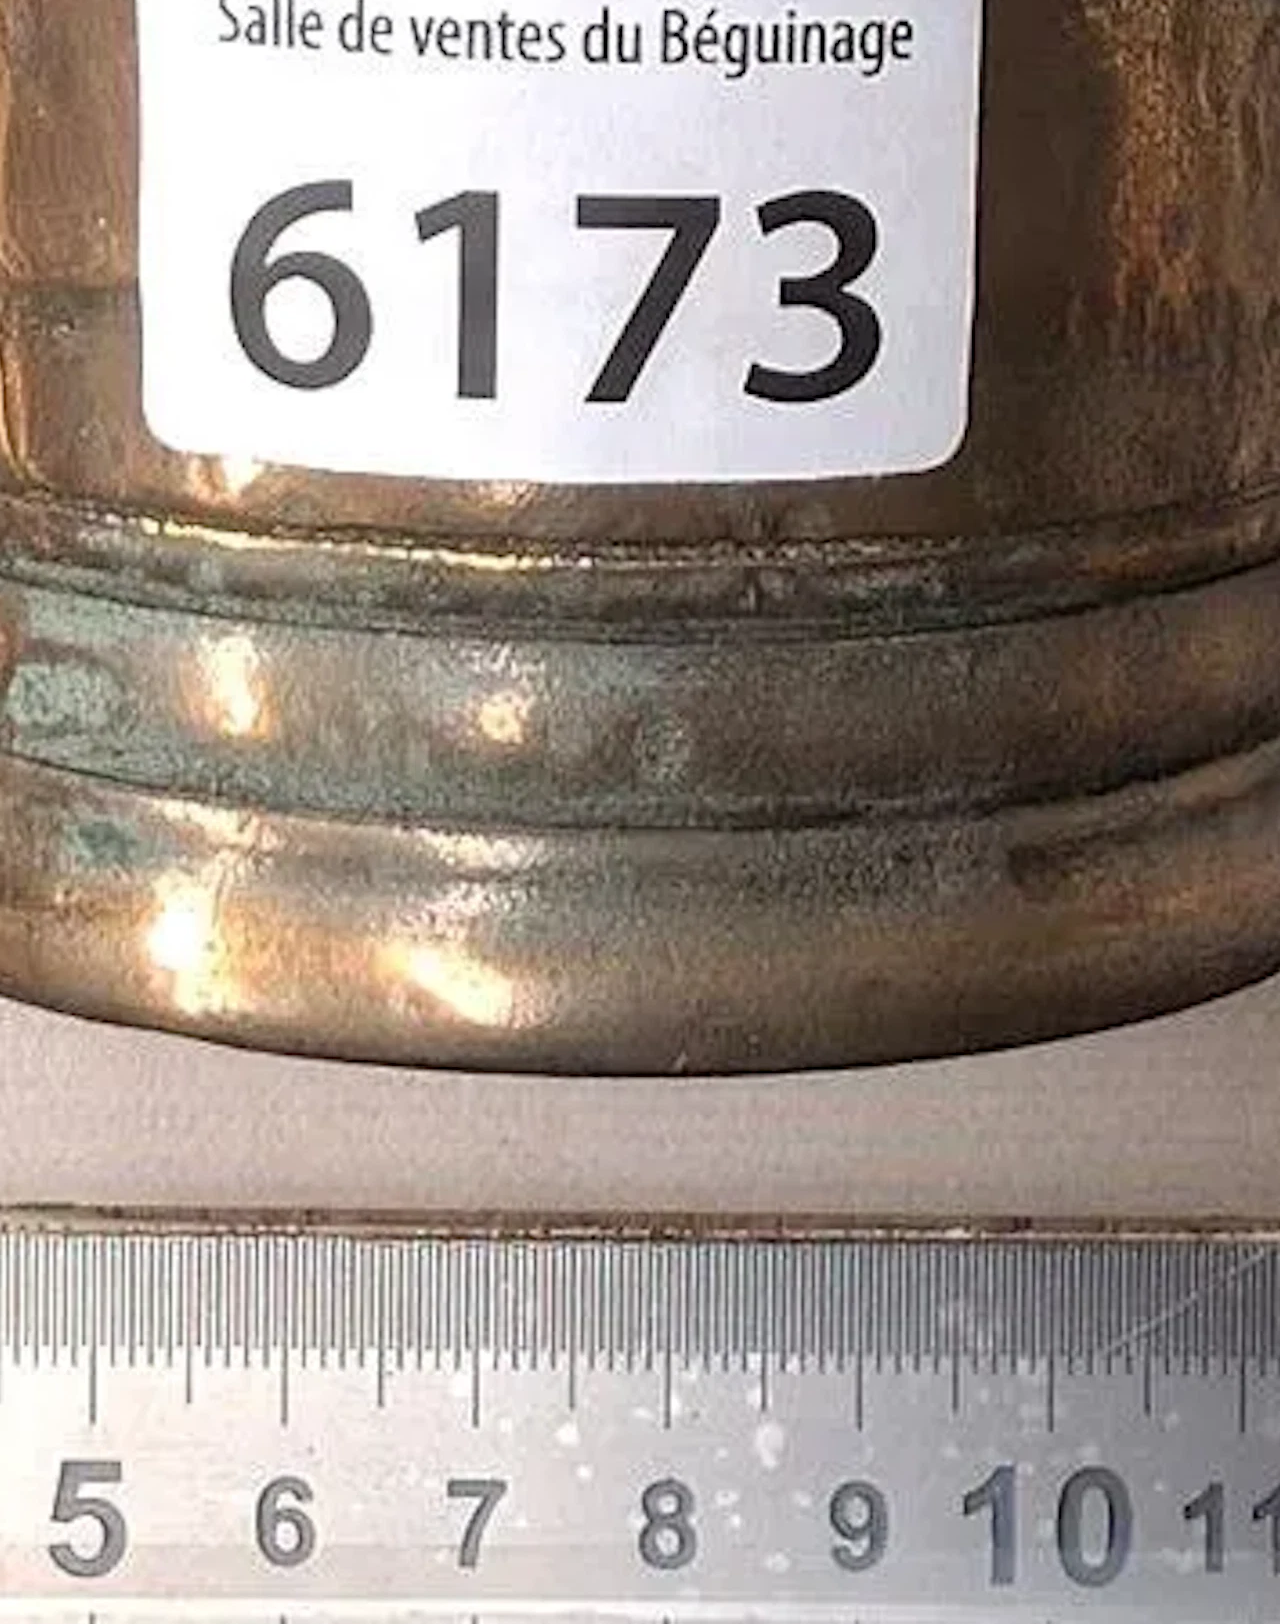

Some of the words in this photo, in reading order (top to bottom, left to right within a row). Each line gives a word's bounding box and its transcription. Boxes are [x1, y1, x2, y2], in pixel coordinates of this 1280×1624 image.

[410, 10, 567, 64] ventes
[583, 5, 643, 66] du
[660, 6, 915, 81] Béguinage
[228, 178, 884, 405] 6173
[46, 1459, 127, 1579] 5
[255, 1475, 317, 1569] 6
[446, 1478, 509, 1572] 7
[638, 1476, 698, 1570] 8
[828, 1479, 890, 1573] 9
[962, 1465, 1134, 1588] 10
